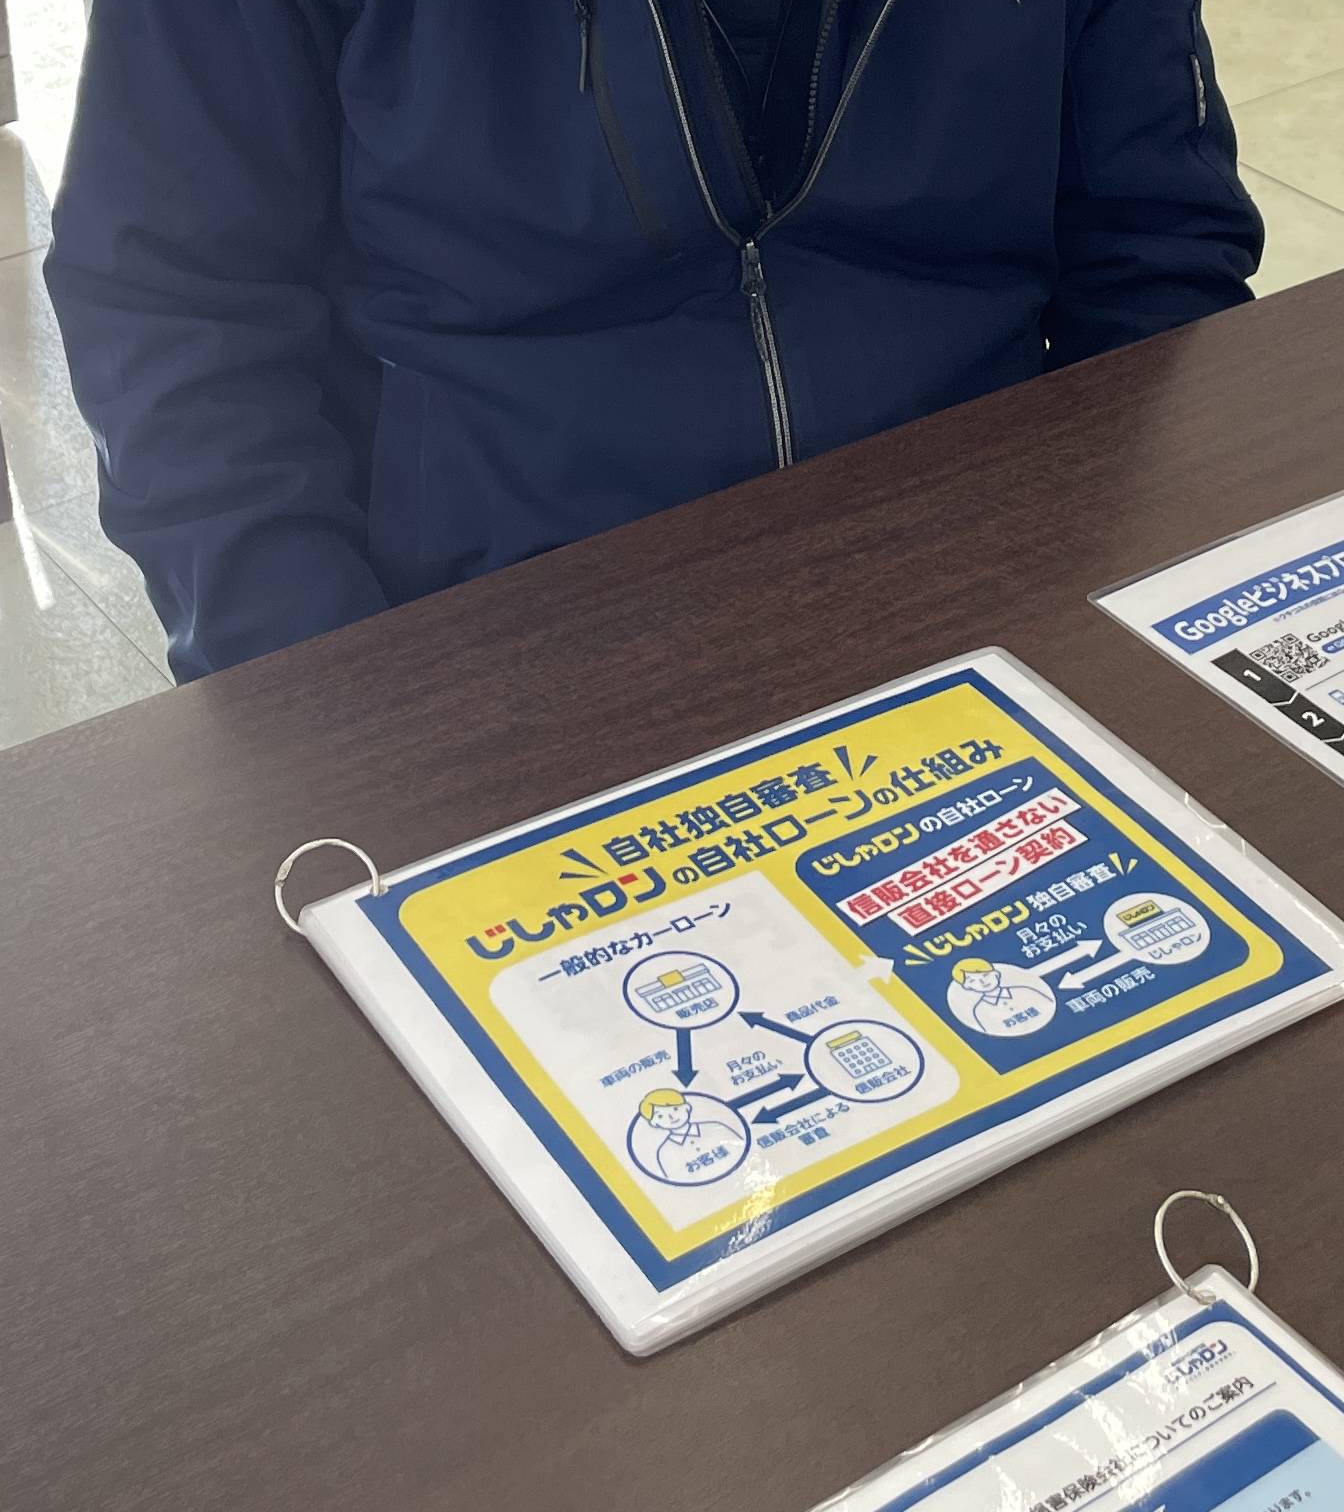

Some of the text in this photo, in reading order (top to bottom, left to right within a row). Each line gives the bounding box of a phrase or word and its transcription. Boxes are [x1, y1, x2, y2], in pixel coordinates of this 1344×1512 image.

[1241, 669, 1262, 682] 1
[1299, 710, 1326, 726] 2
[466, 739, 1005, 960] じしゃロンの自社ローンの仕組み
[602, 761, 839, 867] 自社独自審査
[811, 776, 1033, 876] じしゃロンの自社ローン
[846, 792, 1069, 919] 信販会社を通さない
[897, 826, 1077, 929] 直接ローン契約
[539, 903, 731, 981] 一般的なカーローン
